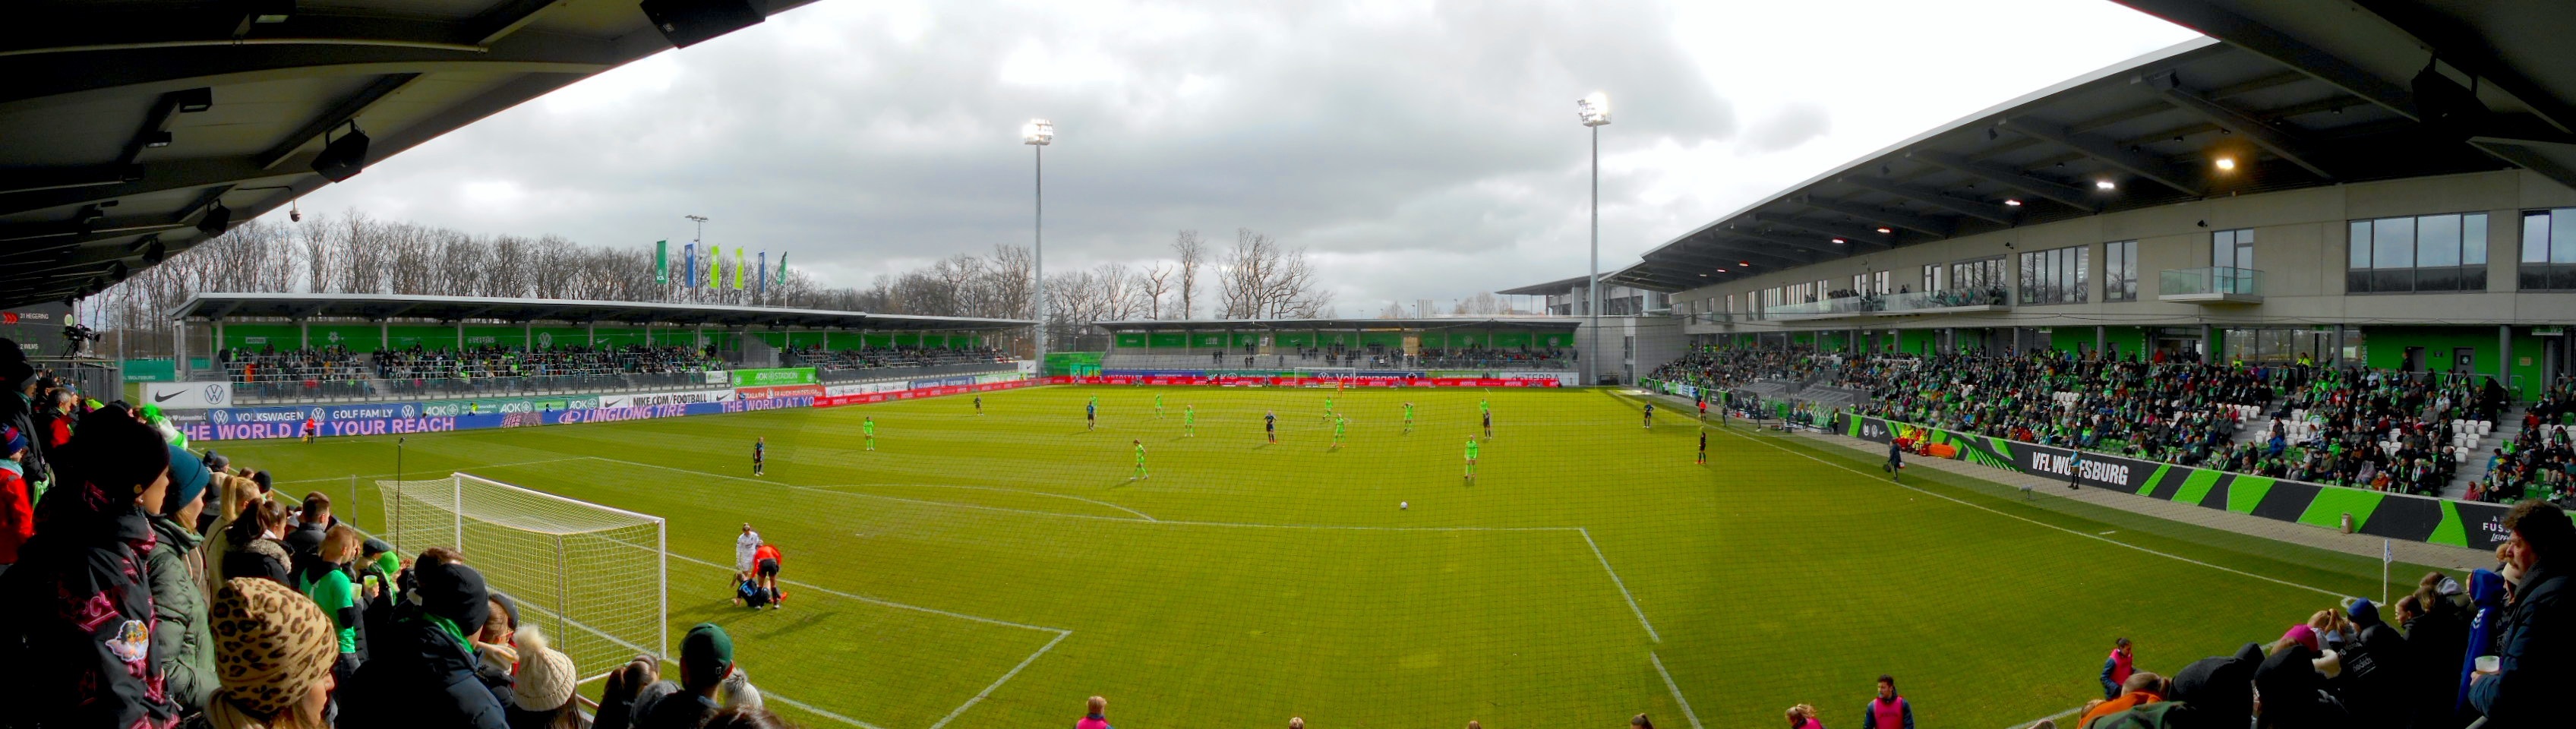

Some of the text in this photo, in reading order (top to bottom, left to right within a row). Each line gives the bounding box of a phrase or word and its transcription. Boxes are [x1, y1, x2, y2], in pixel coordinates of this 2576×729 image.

[570, 399, 588, 409] AOK
[633, 393, 707, 407] NIKE.COM/FOOTBALL
[721, 400, 743, 413] THE
[746, 398, 783, 412] WORLD
[785, 397, 798, 408] AT
[333, 409, 393, 419] GOLF FAMILY
[426, 406, 447, 416] AOK
[500, 403, 521, 413] AOK
[583, 403, 685, 423] LINGLONG TIRE
[235, 412, 304, 421] VOLKSWAGEN
[217, 422, 292, 440] WORLD
[332, 419, 386, 437] YOUR
[392, 417, 454, 434] REACH
[2032, 452, 2129, 485] VFL WOFSBURG
